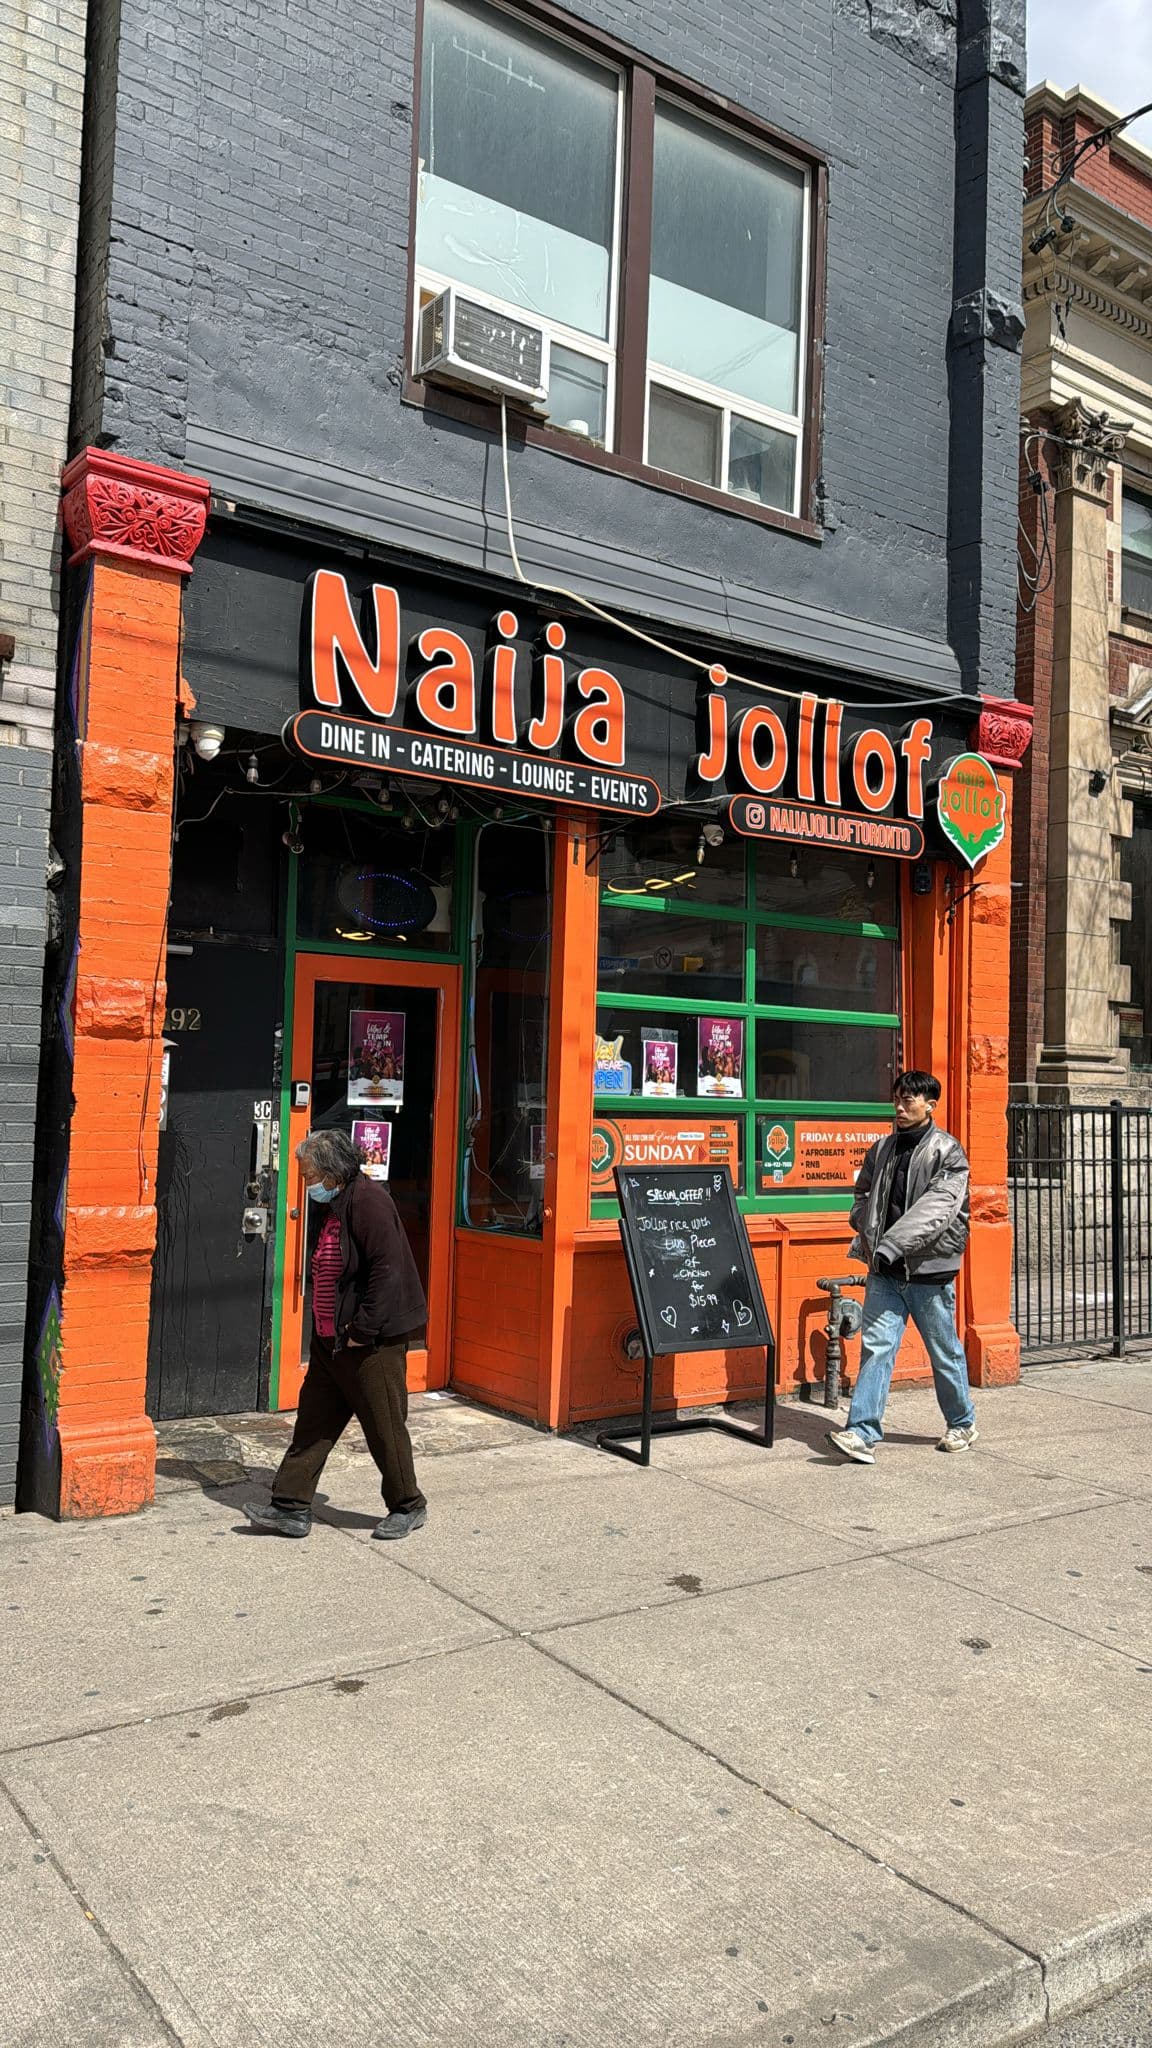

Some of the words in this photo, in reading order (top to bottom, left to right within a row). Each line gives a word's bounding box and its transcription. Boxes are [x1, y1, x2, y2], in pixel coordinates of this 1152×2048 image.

[311, 569, 625, 766] Naija
[698, 663, 932, 820] jollof
[320, 722, 366, 756] DINE
[371, 732, 391, 760] IN
[410, 740, 495, 781] CATERING
[512, 760, 575, 795] LOUNGE
[591, 775, 649, 808] EVENTS
[942, 783, 1001, 819] jollof
[770, 806, 911, 852] NAIJAJOLLOFTORONTO
[367, 1033, 388, 1041] TEMP
[608, 1060, 624, 1070] ARE
[594, 1071, 624, 1089] PEN
[254, 1101, 271, 1118] 3C
[800, 1133, 832, 1142] FRIDAY
[836, 1133, 843, 1142] &
[624, 1144, 697, 1161] SUNDAY
